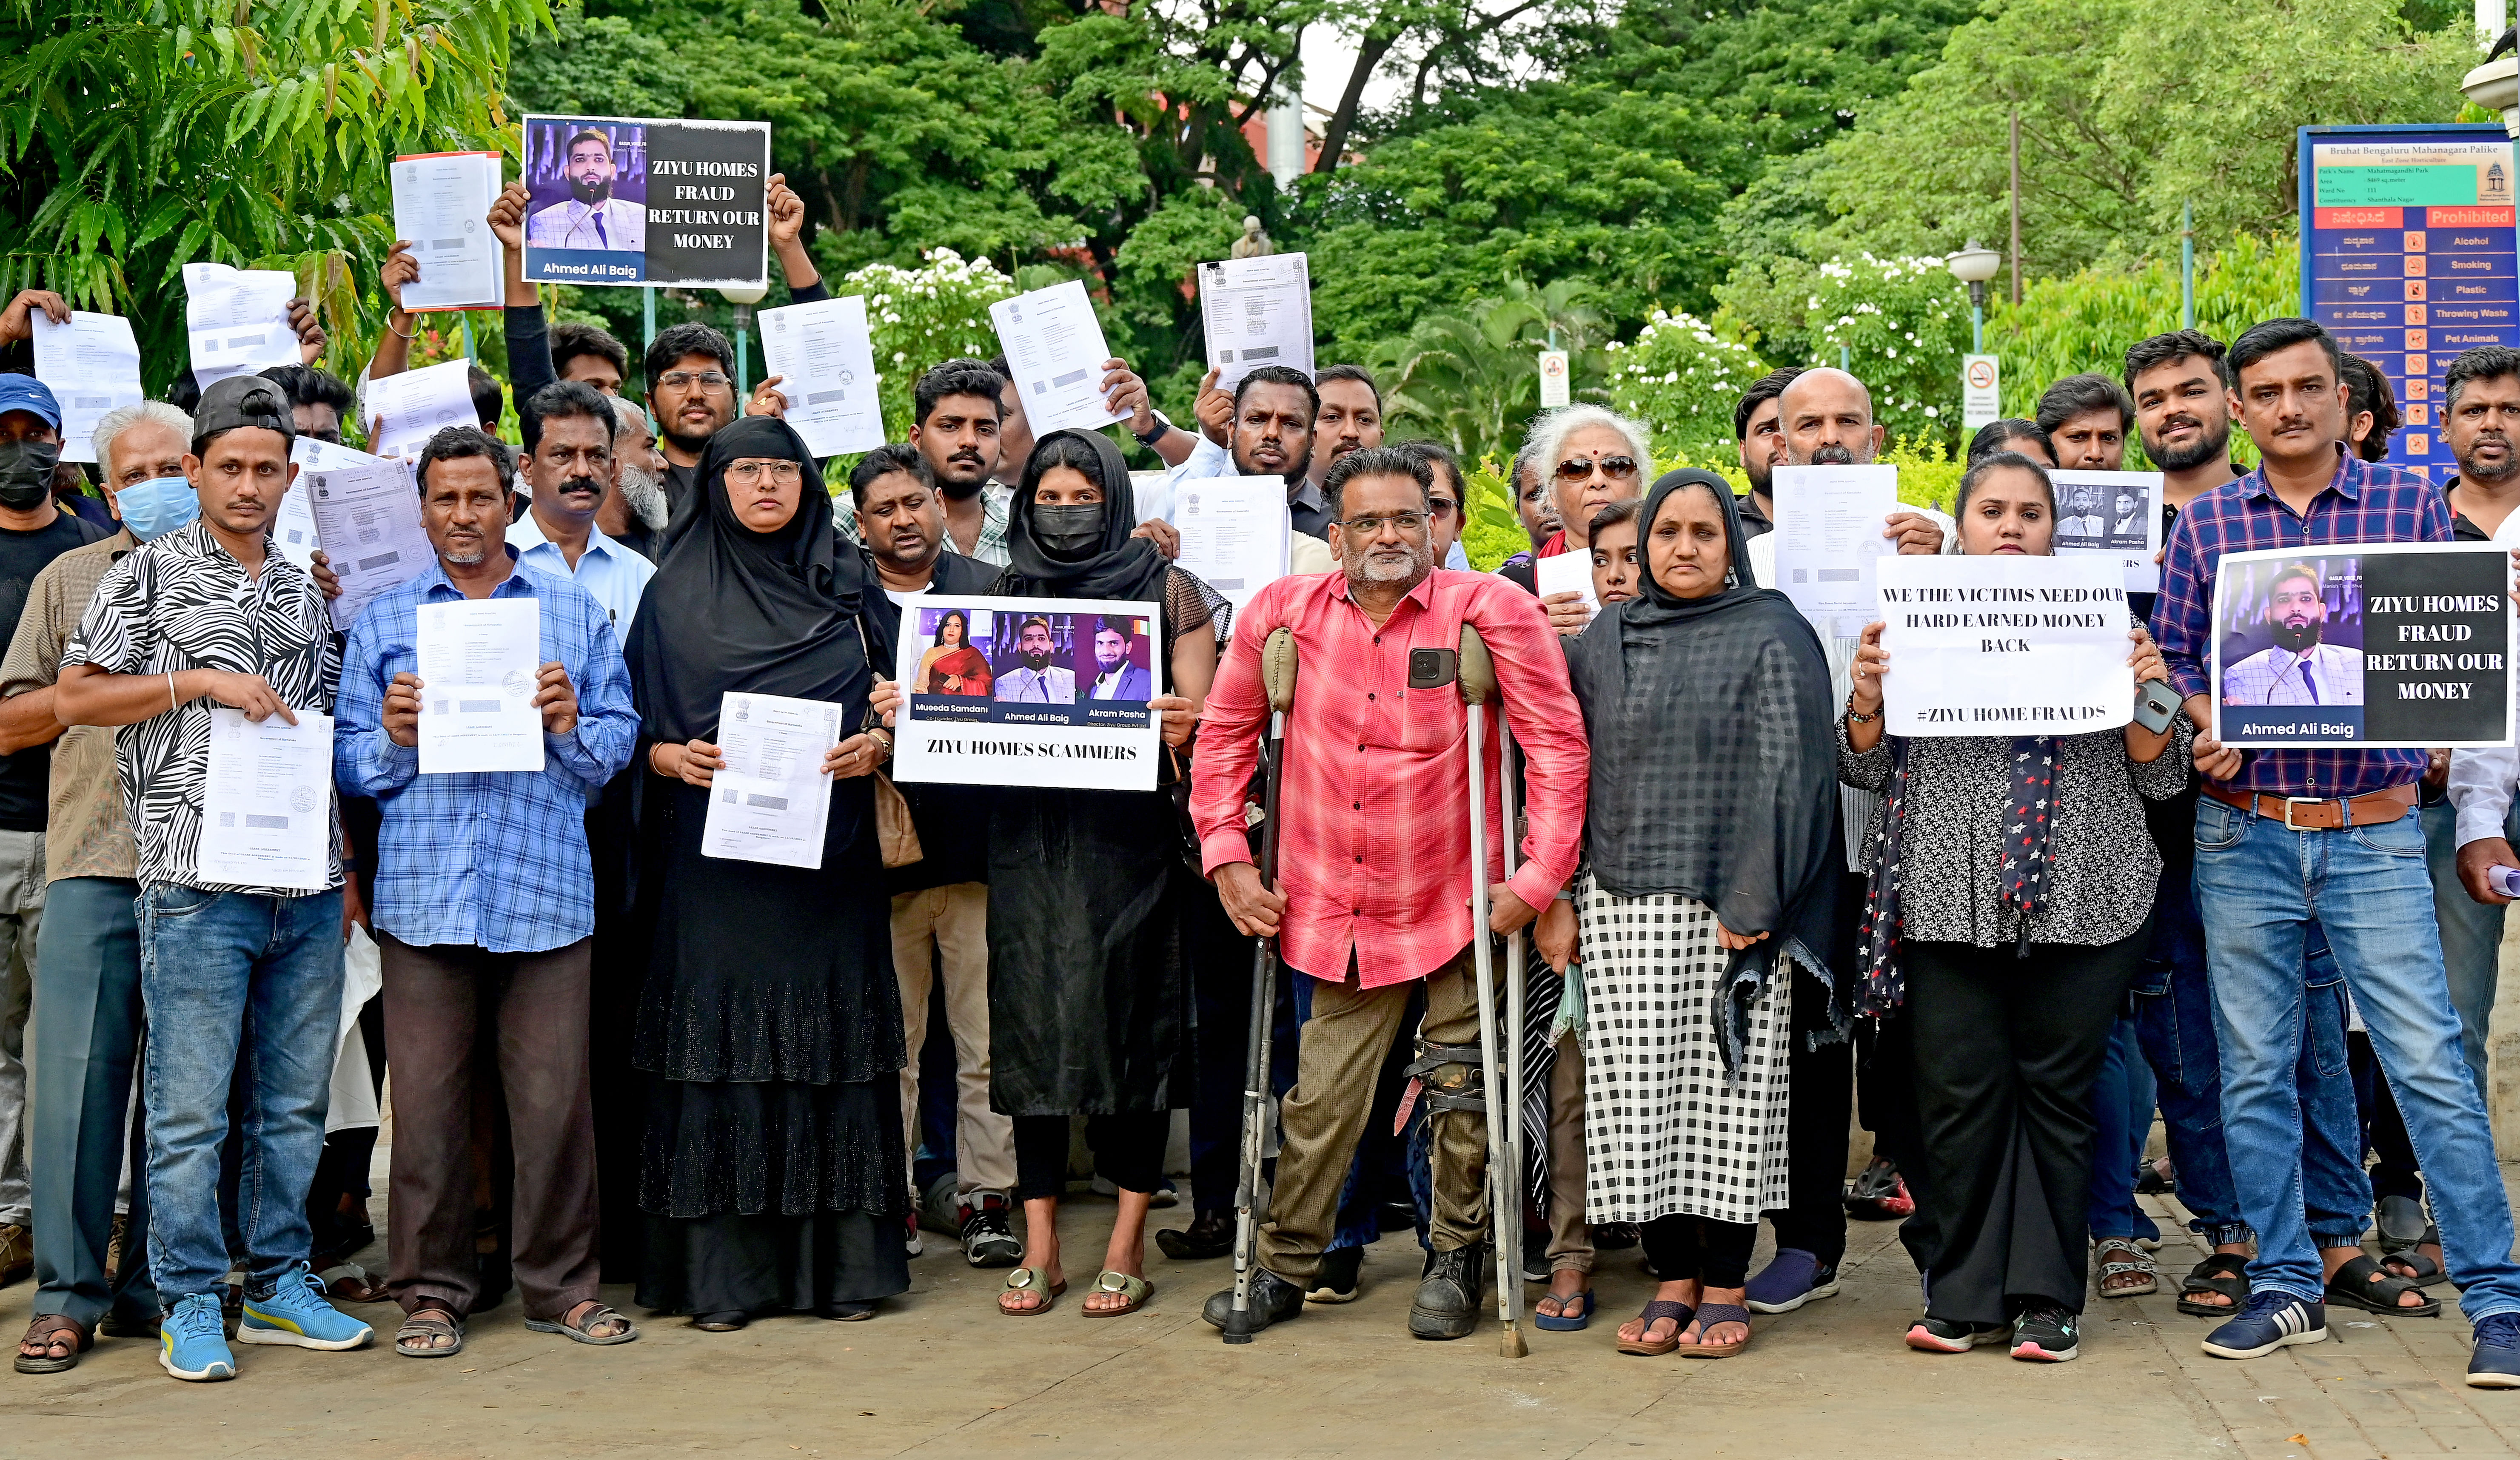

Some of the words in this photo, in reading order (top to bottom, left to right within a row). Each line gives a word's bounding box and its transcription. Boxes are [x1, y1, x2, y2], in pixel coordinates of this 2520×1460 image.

[2363, 147, 2409, 157] Bengaluru
[2413, 146, 2467, 156] Mahanagara
[653, 160, 693, 175] ZIYU
[696, 162, 758, 177] HOMES
[675, 185, 735, 201] FRAUD
[648, 209, 720, 225] RETURN
[722, 211, 760, 226] OUR
[2333, 211, 2385, 225] ನಿಷೇಧಿಸಿದೆ
[2432, 211, 2509, 223] Prohibited
[673, 234, 735, 249] MONEY
[543, 263, 588, 274] Ahmed
[590, 264, 606, 275] Ali
[609, 265, 637, 279] Baig
[2452, 261, 2492, 270] Smoking
[2456, 285, 2487, 294] Plastic
[2435, 310, 2479, 319] Throwing
[2445, 335, 2461, 343] Pet
[2462, 334, 2499, 342] Animals
[1883, 589, 1912, 603] WE
[1916, 588, 1953, 602] THE
[1958, 588, 2034, 602] VICTIMS
[2038, 589, 2088, 602] NEED
[2092, 588, 2124, 601] OUR
[2370, 596, 2418, 613] ZIYU
[2423, 595, 2499, 612] HOMES
[1906, 614, 1958, 628] HARD
[1963, 614, 2038, 627] EARNED
[2042, 613, 2107, 627] MONEY
[2398, 625, 2472, 642] FRAUD
[1981, 639, 2030, 653] BACK
[2366, 654, 2454, 671] RETURN
[2457, 653, 2503, 670] OUR
[2398, 683, 2473, 700] MONEY
[916, 704, 949, 712] Mueeda
[951, 705, 988, 713] Samdani
[1089, 709, 1117, 718] Akram
[1119, 710, 1146, 719] Pasha
[1917, 708, 1970, 722] #ZIYU
[1974, 707, 2027, 722] HOME
[2033, 706, 2106, 721] FRAUDS
[1004, 713, 1036, 721] Ahmed
[1037, 713, 1048, 722] Ali
[1050, 714, 1069, 724] Baig
[2242, 723, 2295, 735] Ahmed
[2299, 723, 2318, 735] Ali
[2321, 723, 2354, 738] Baig
[927, 739, 967, 754] ZIYU
[972, 741, 1034, 757] HOMES
[1038, 743, 1136, 760] SCAMMERS
